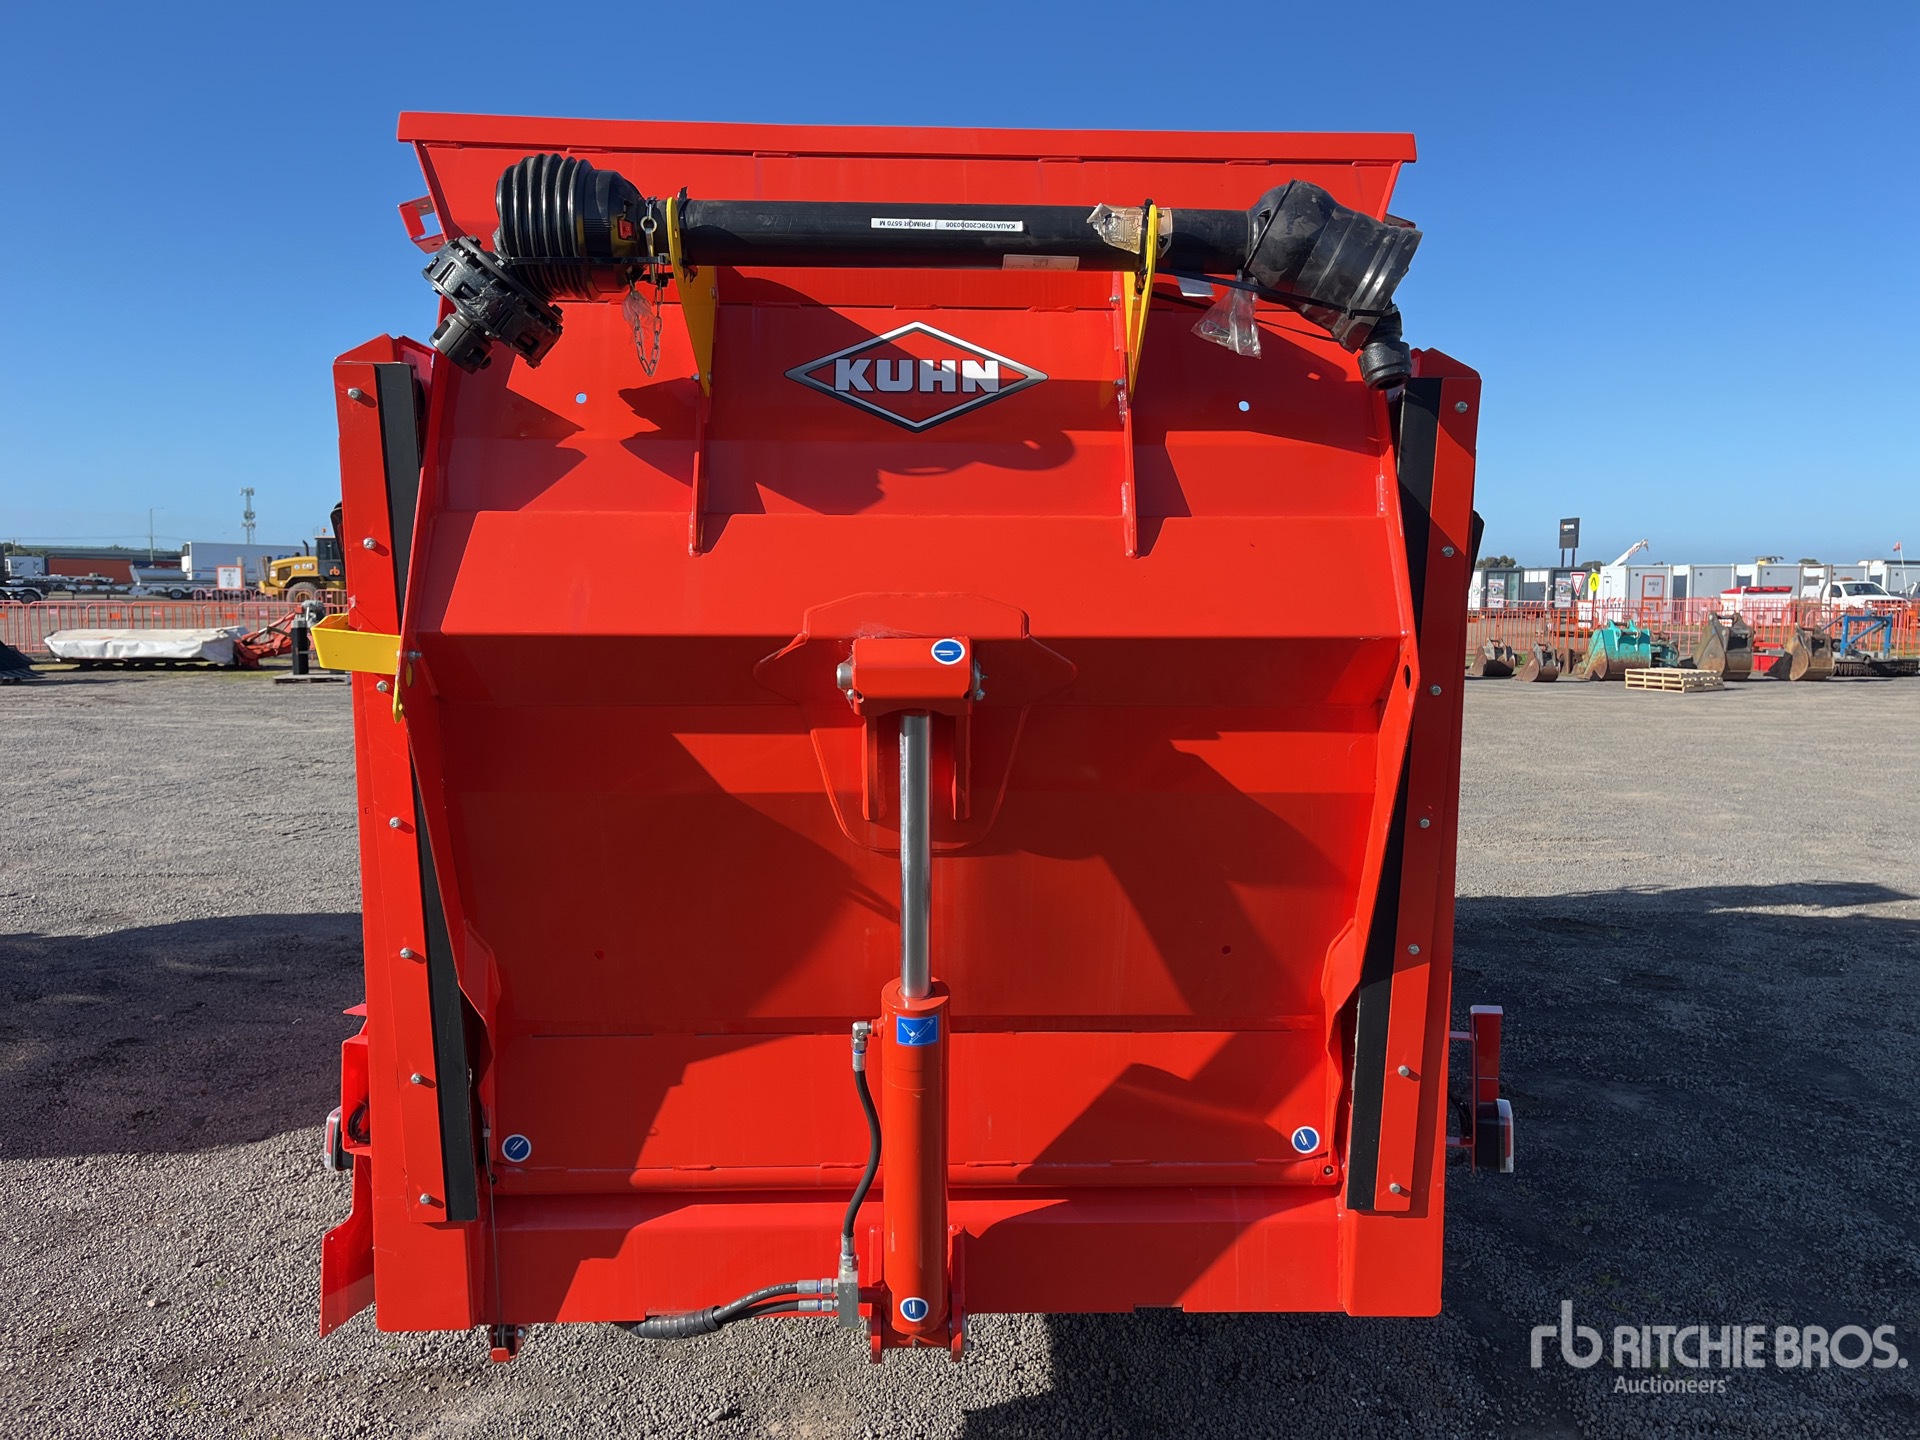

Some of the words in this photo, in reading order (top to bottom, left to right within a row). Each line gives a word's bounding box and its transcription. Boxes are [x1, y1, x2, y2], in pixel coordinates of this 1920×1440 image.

[903, 220, 931, 228] PRIMOR
[833, 358, 1000, 393] KUHN
[329, 566, 340, 576] rb
